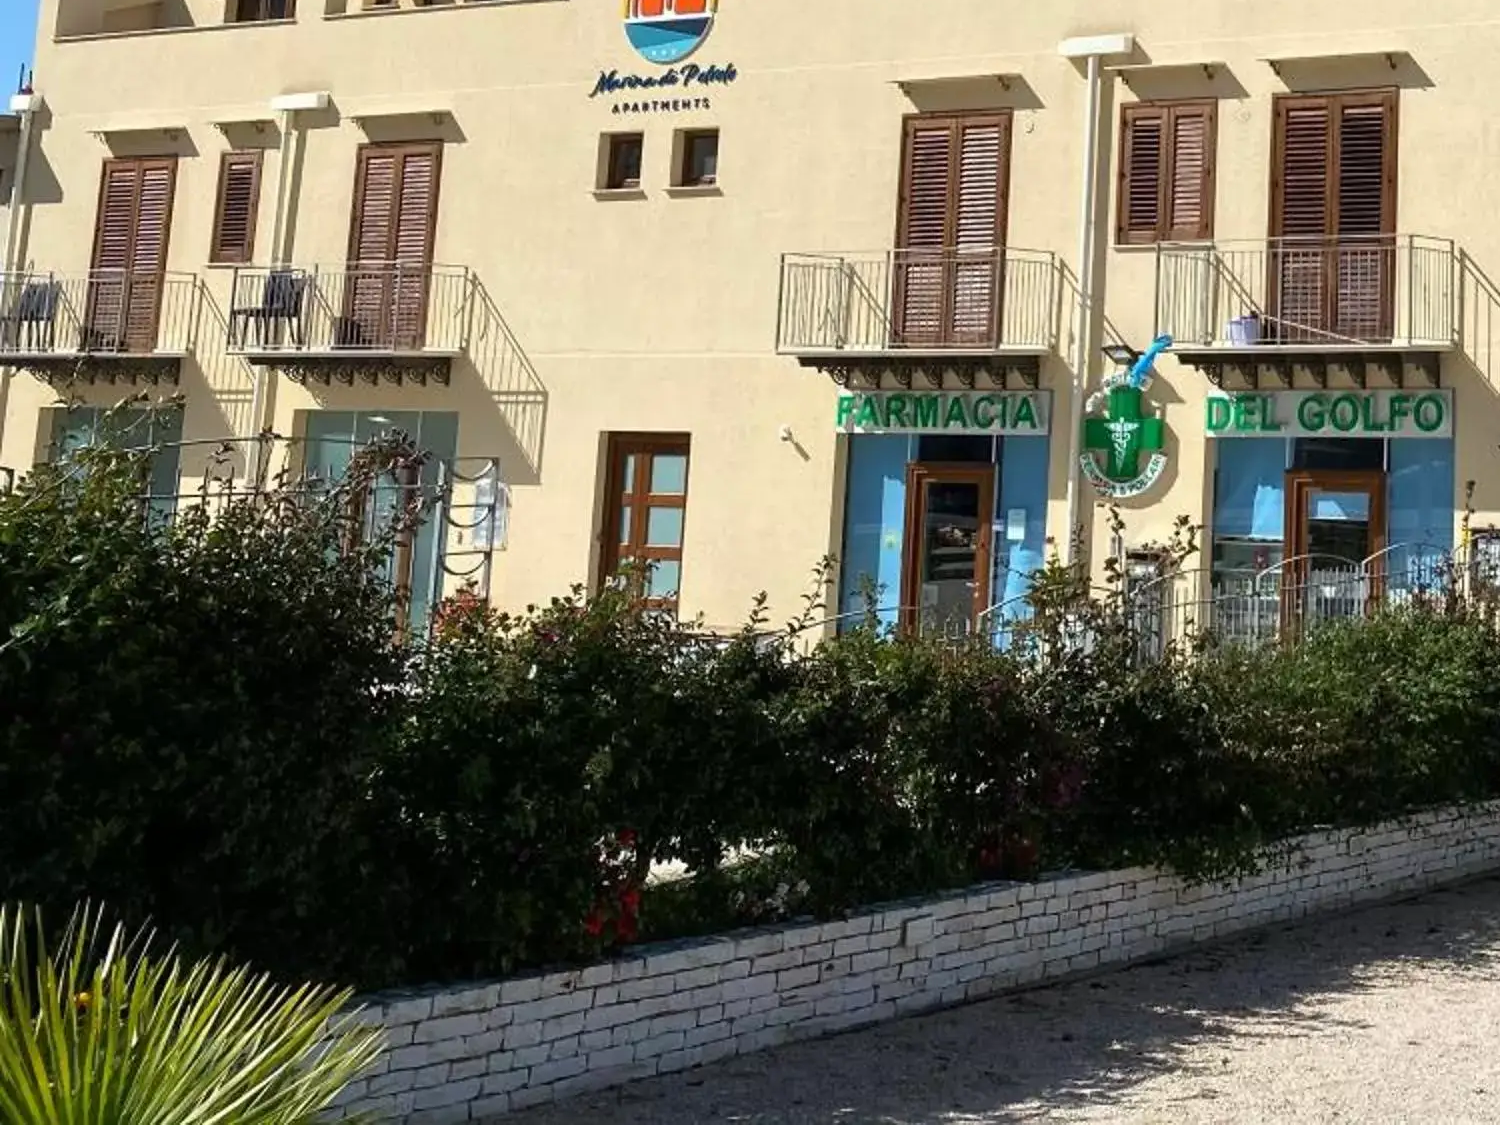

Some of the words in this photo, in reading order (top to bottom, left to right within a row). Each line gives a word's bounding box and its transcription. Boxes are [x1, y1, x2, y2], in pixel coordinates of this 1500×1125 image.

[612, 97, 711, 115] APARTMENTS
[836, 394, 1038, 429] FARMACIA
[1206, 394, 1282, 431] DEL
[1297, 393, 1444, 431] GOLFO
